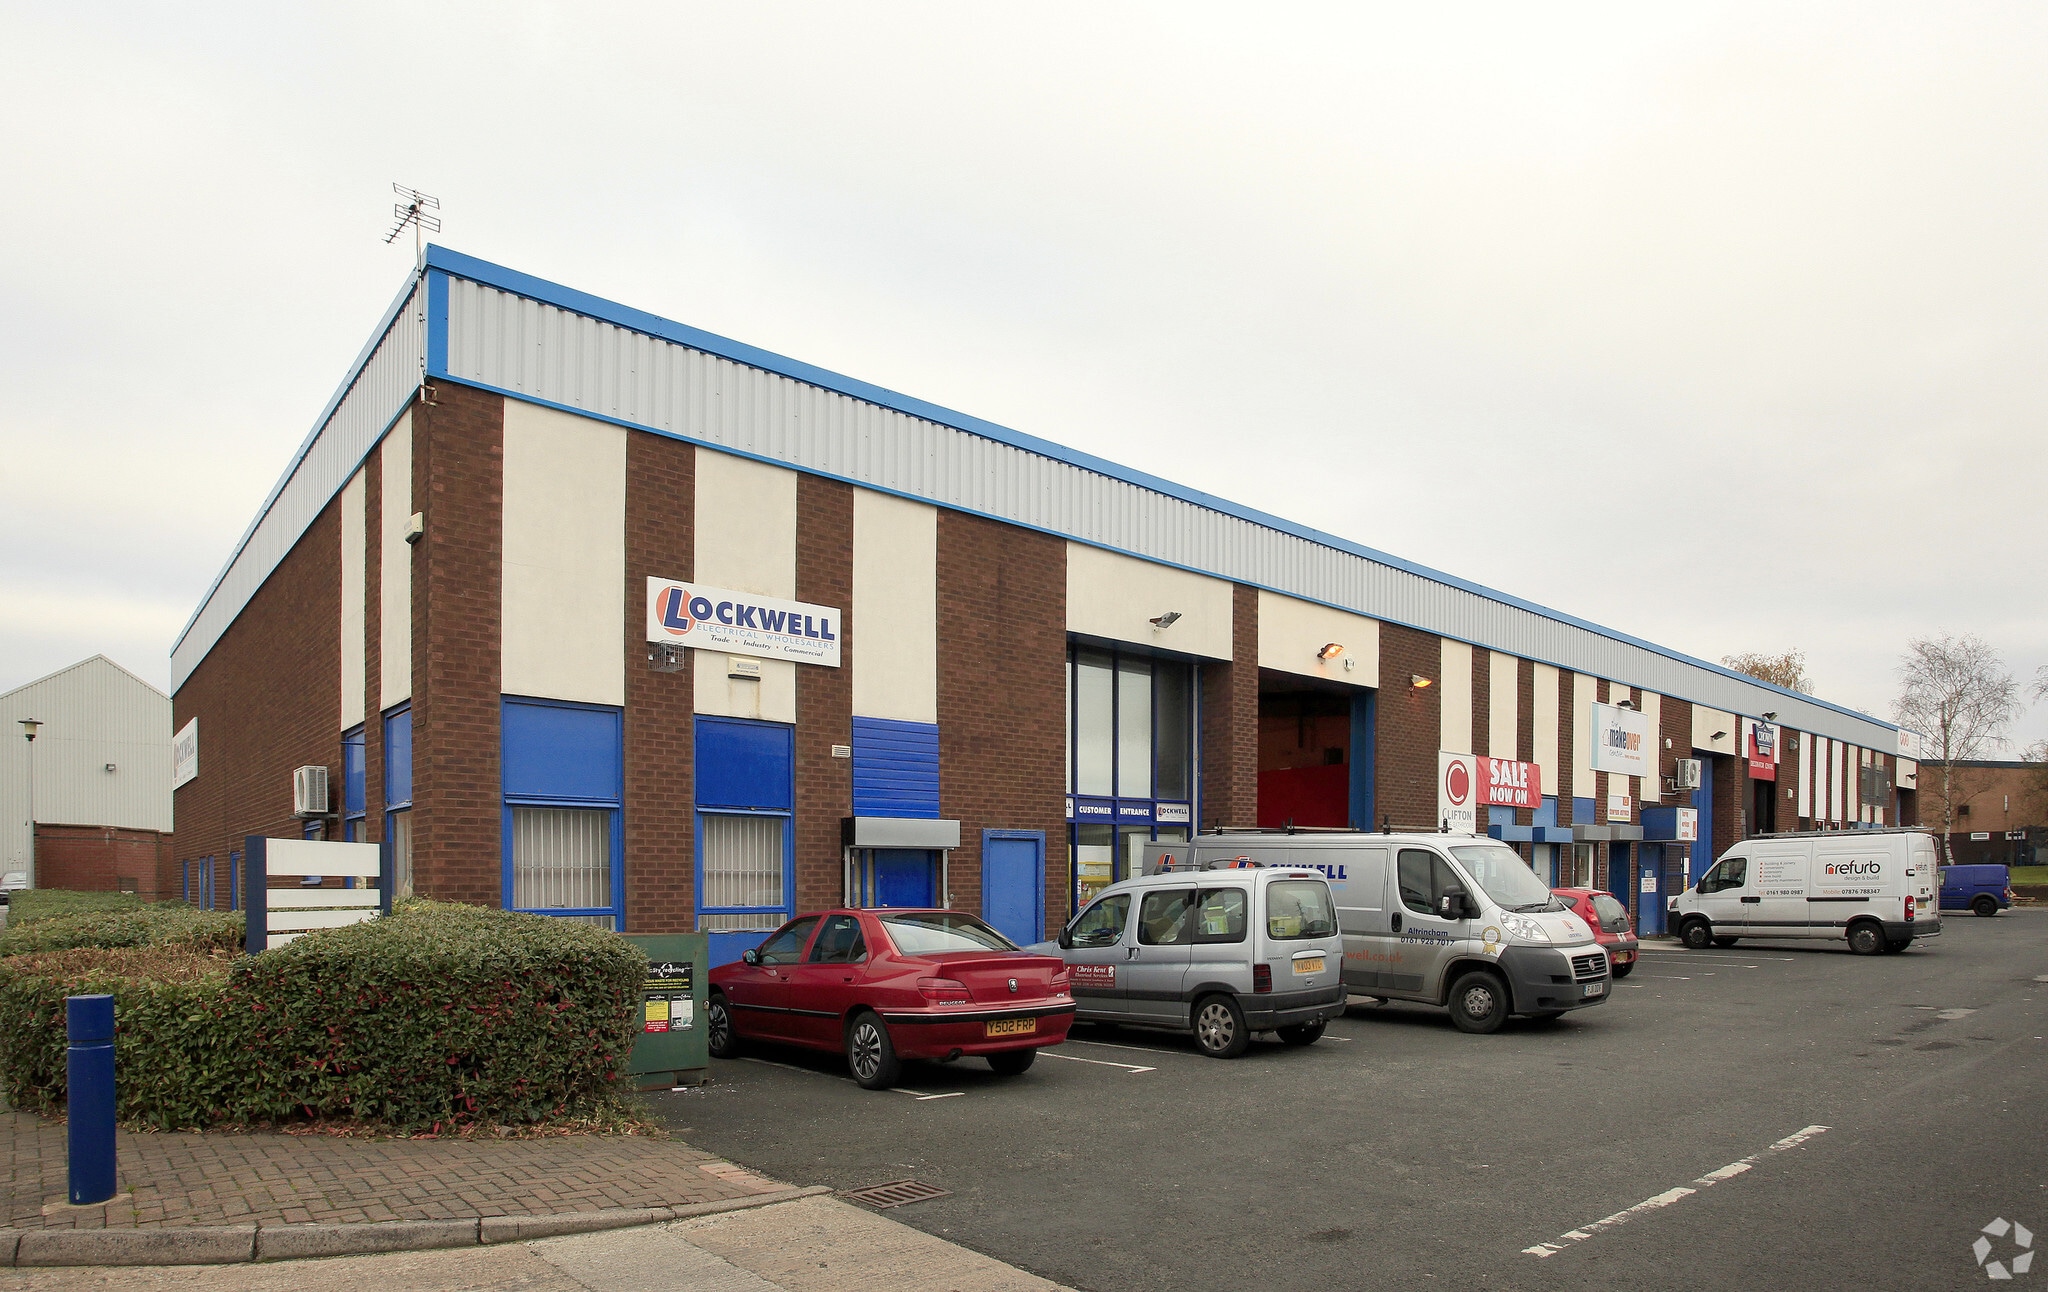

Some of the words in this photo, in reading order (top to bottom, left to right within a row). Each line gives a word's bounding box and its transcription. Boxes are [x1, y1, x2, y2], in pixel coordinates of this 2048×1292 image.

[663, 588, 835, 641] LOCKWELL
[696, 624, 758, 639] ELECTRICAL
[765, 634, 834, 651] WHOLESALERS
[710, 634, 731, 643] Trade
[743, 639, 771, 650] Industry
[783, 645, 824, 657] Commercial
[1609, 726, 1641, 751] makeover
[1489, 759, 1528, 788] SALE
[1489, 786, 1513, 802] NOW
[1515, 789, 1528, 804] ON
[1078, 805, 1112, 815] CUSTOMER
[1119, 807, 1150, 816] ENTRANCE
[1158, 807, 1188, 818] LOCKWELL
[1442, 807, 1472, 821] CLIFTON
[1408, 927, 1449, 937] Altrincham
[1436, 939, 1455, 947] 7017
[1076, 965, 1092, 973] Chris
[1093, 966, 1107, 974] Kent
[988, 1020, 1014, 1034] Y502
[1016, 1018, 1035, 1032] FRP
